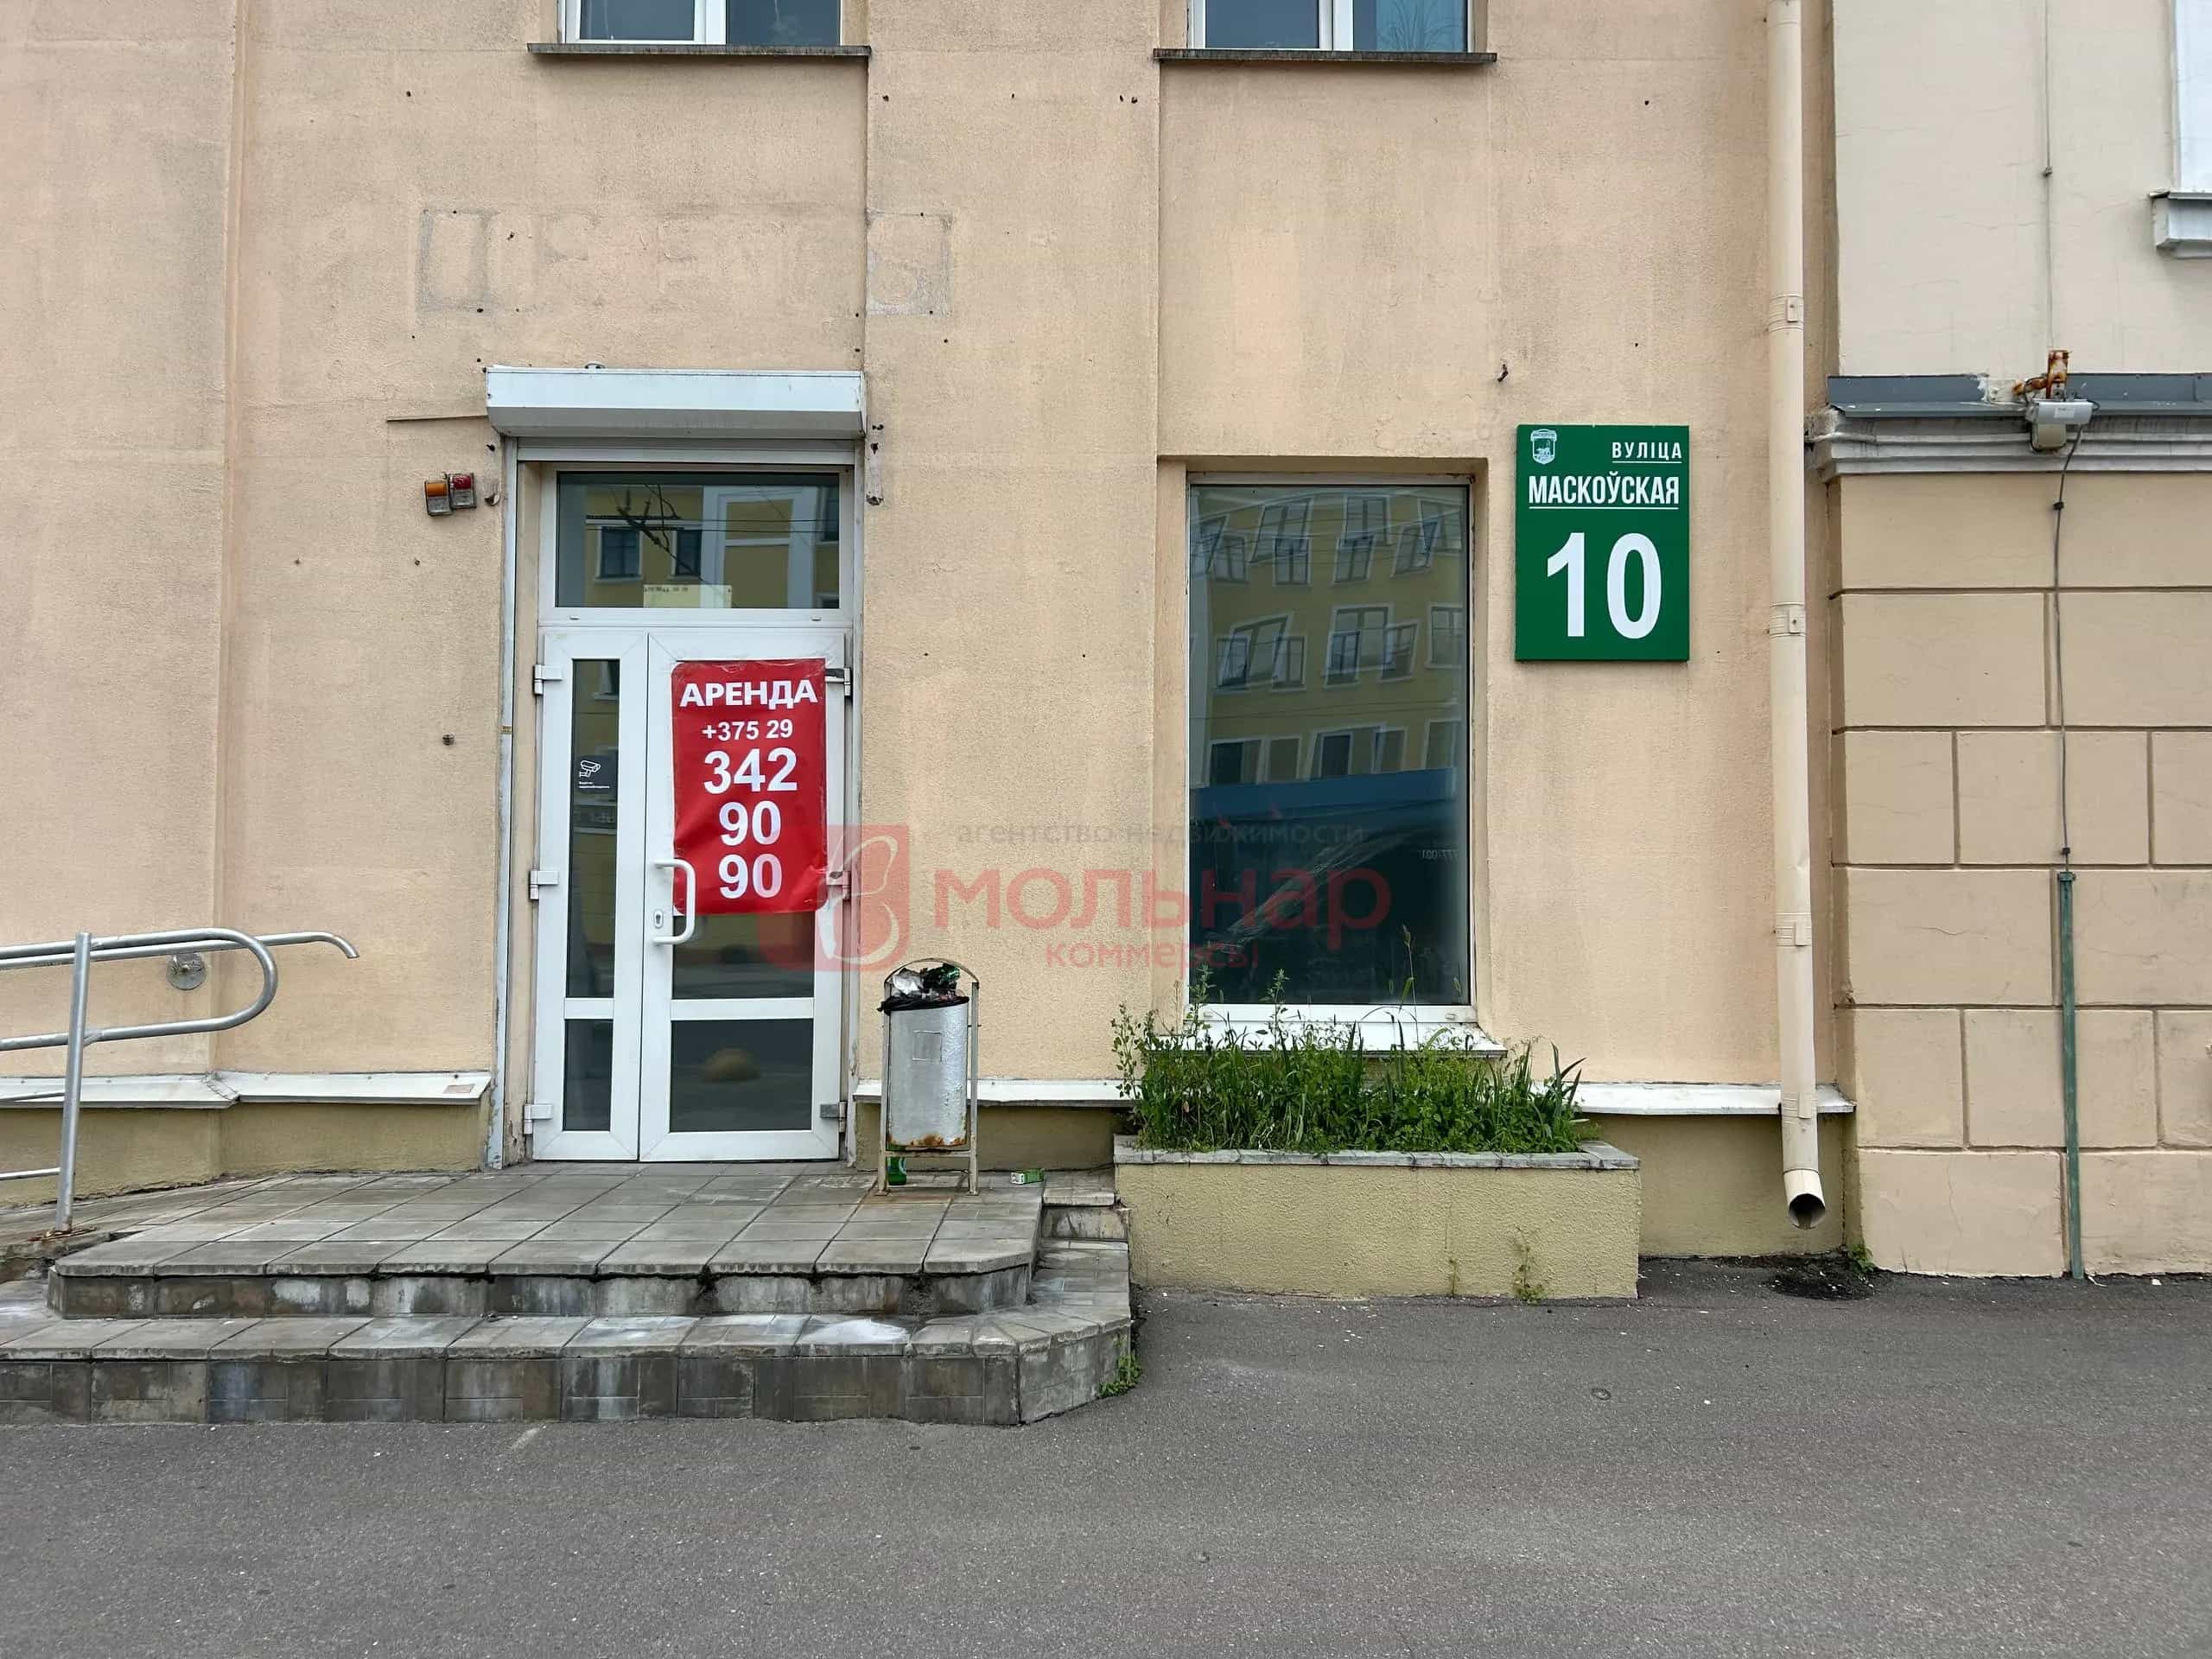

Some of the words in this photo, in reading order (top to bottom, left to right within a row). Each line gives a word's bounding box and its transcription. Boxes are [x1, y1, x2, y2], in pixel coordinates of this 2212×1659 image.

[1611, 442, 1682, 461] ВУЛІЦА
[1529, 471, 1679, 504] МАСКОЎСКАЯ
[1547, 532, 1662, 639] 10
[679, 679, 818, 710] АРЕНДА
[702, 721, 760, 741] +375
[766, 719, 793, 739] 29
[703, 747, 798, 794] 342
[719, 800, 781, 846] 90
[718, 853, 783, 899] 90
